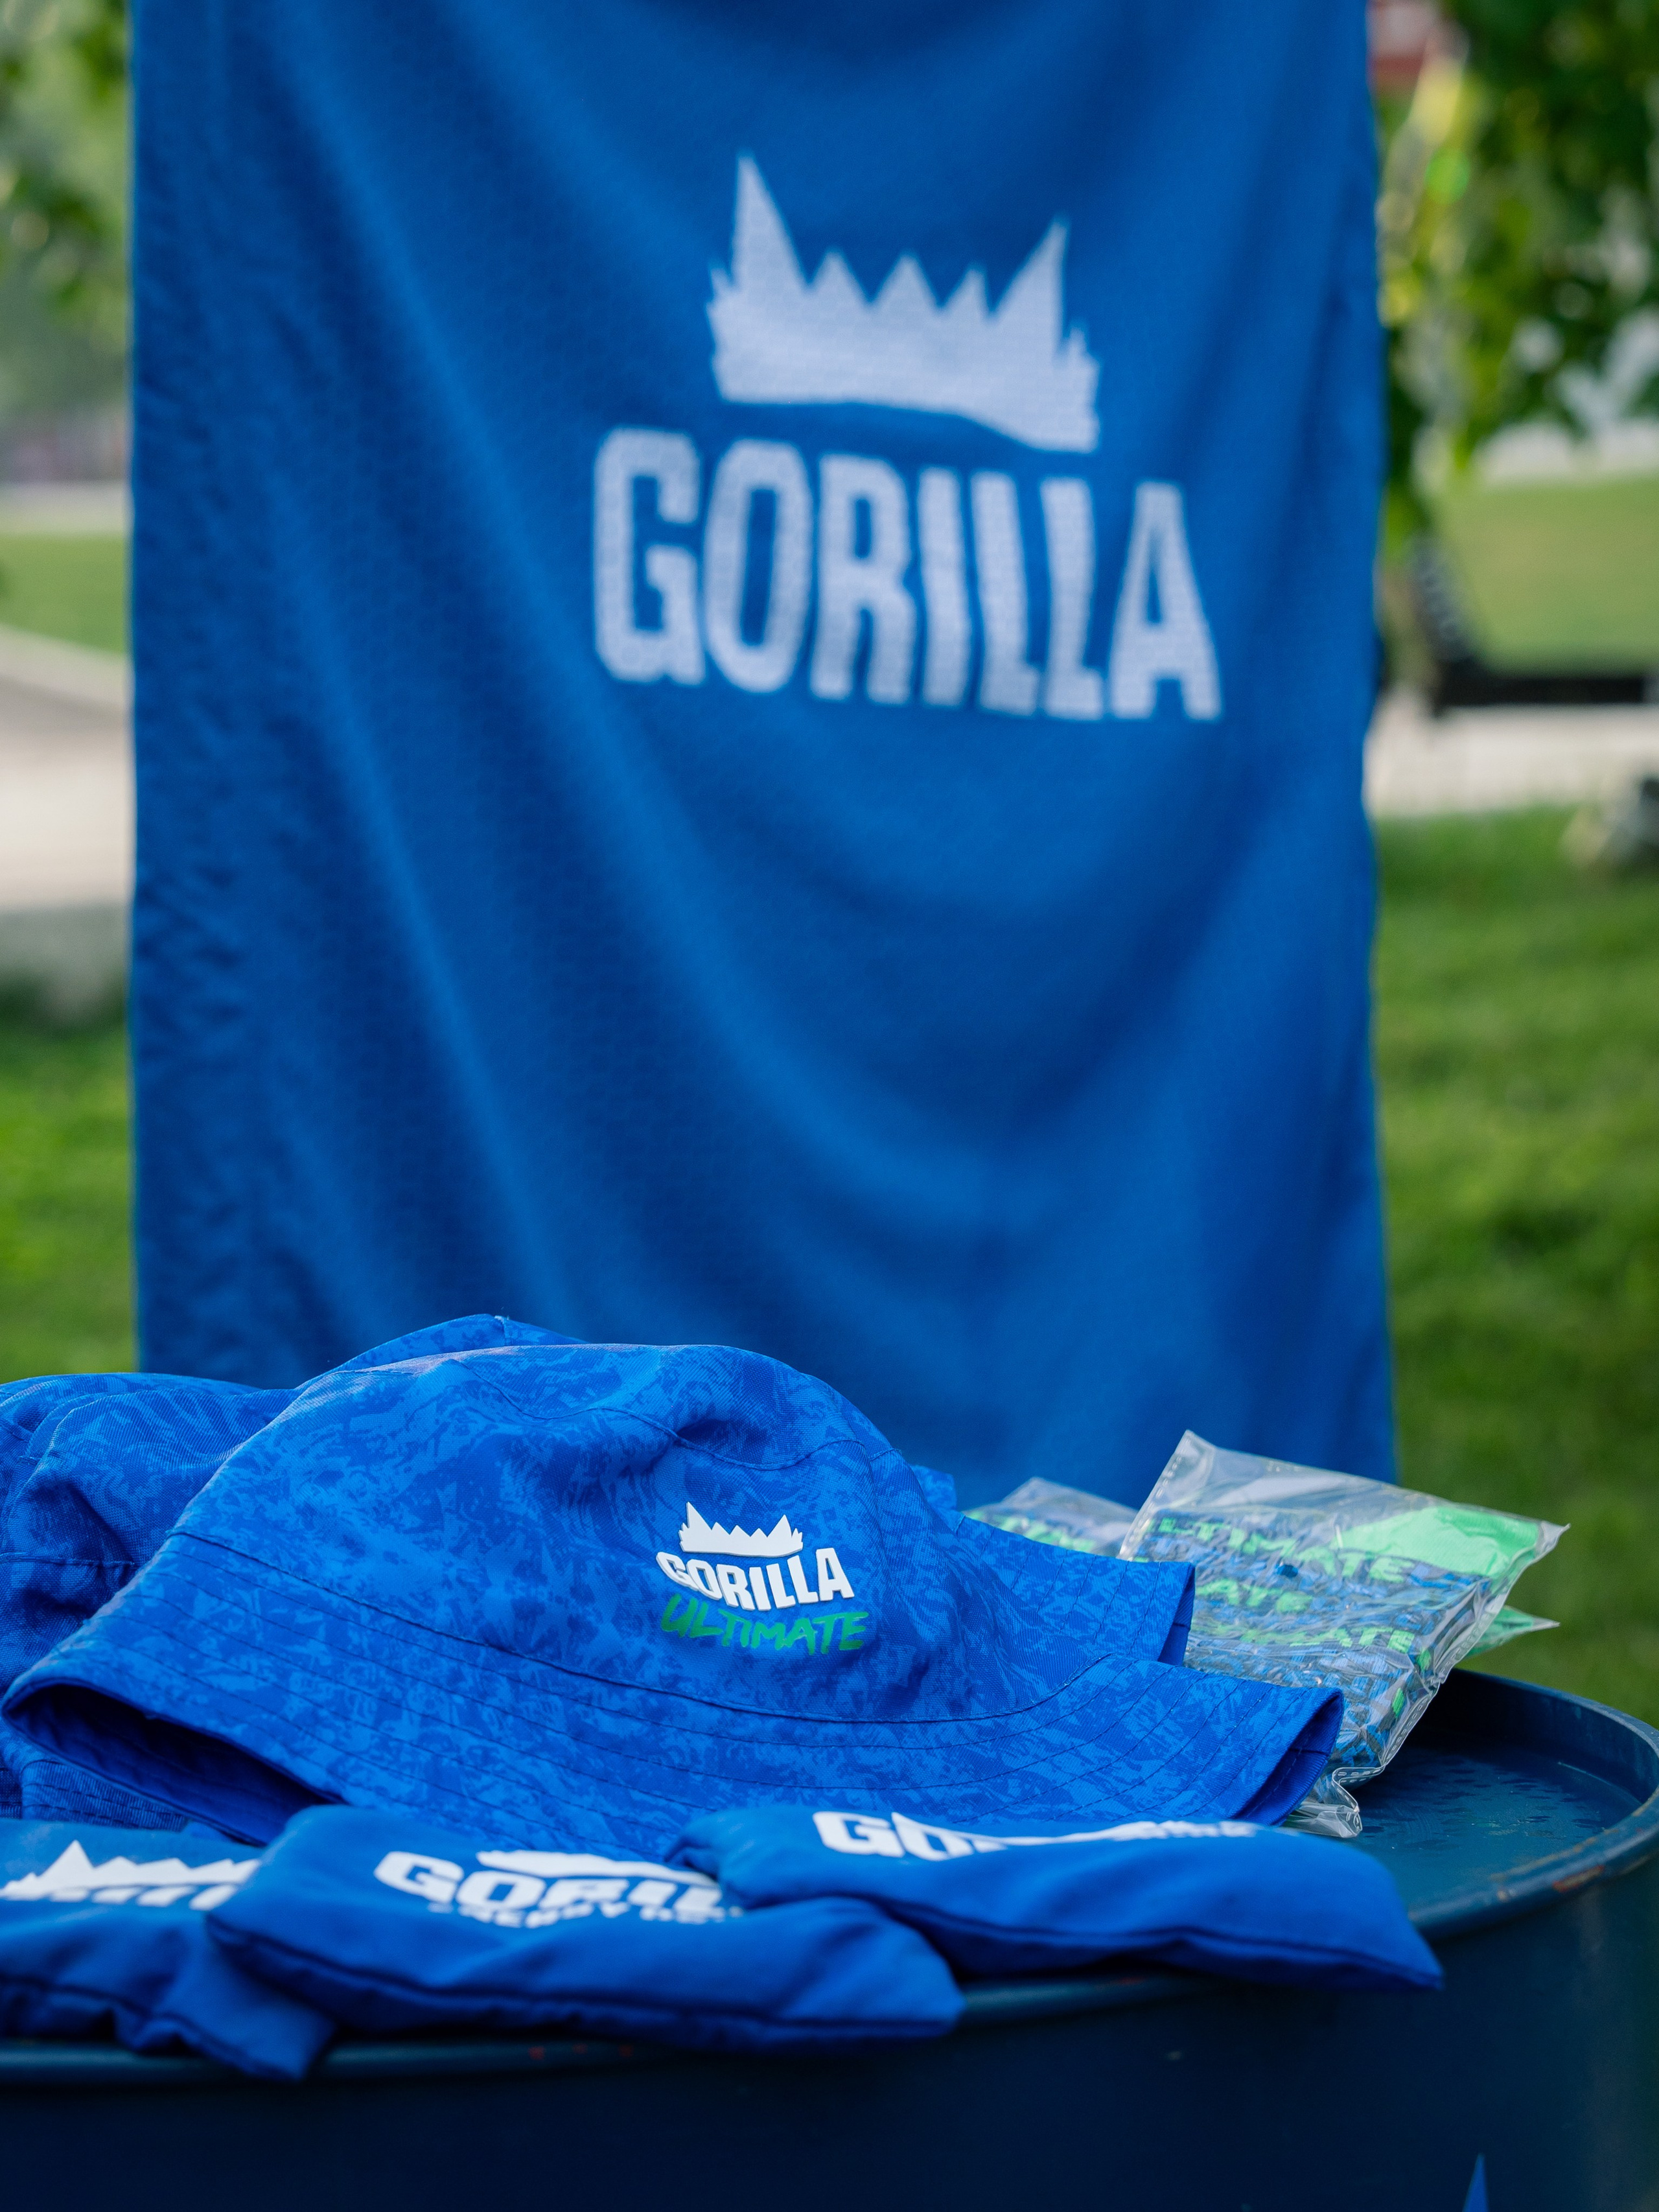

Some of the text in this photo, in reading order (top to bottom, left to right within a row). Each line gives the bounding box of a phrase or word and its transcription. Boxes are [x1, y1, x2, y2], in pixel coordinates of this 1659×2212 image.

[593, 425, 1222, 722] GORILLA
[656, 1548, 855, 1611] GORILLA
[660, 1593, 869, 1655] ULTIMATE
